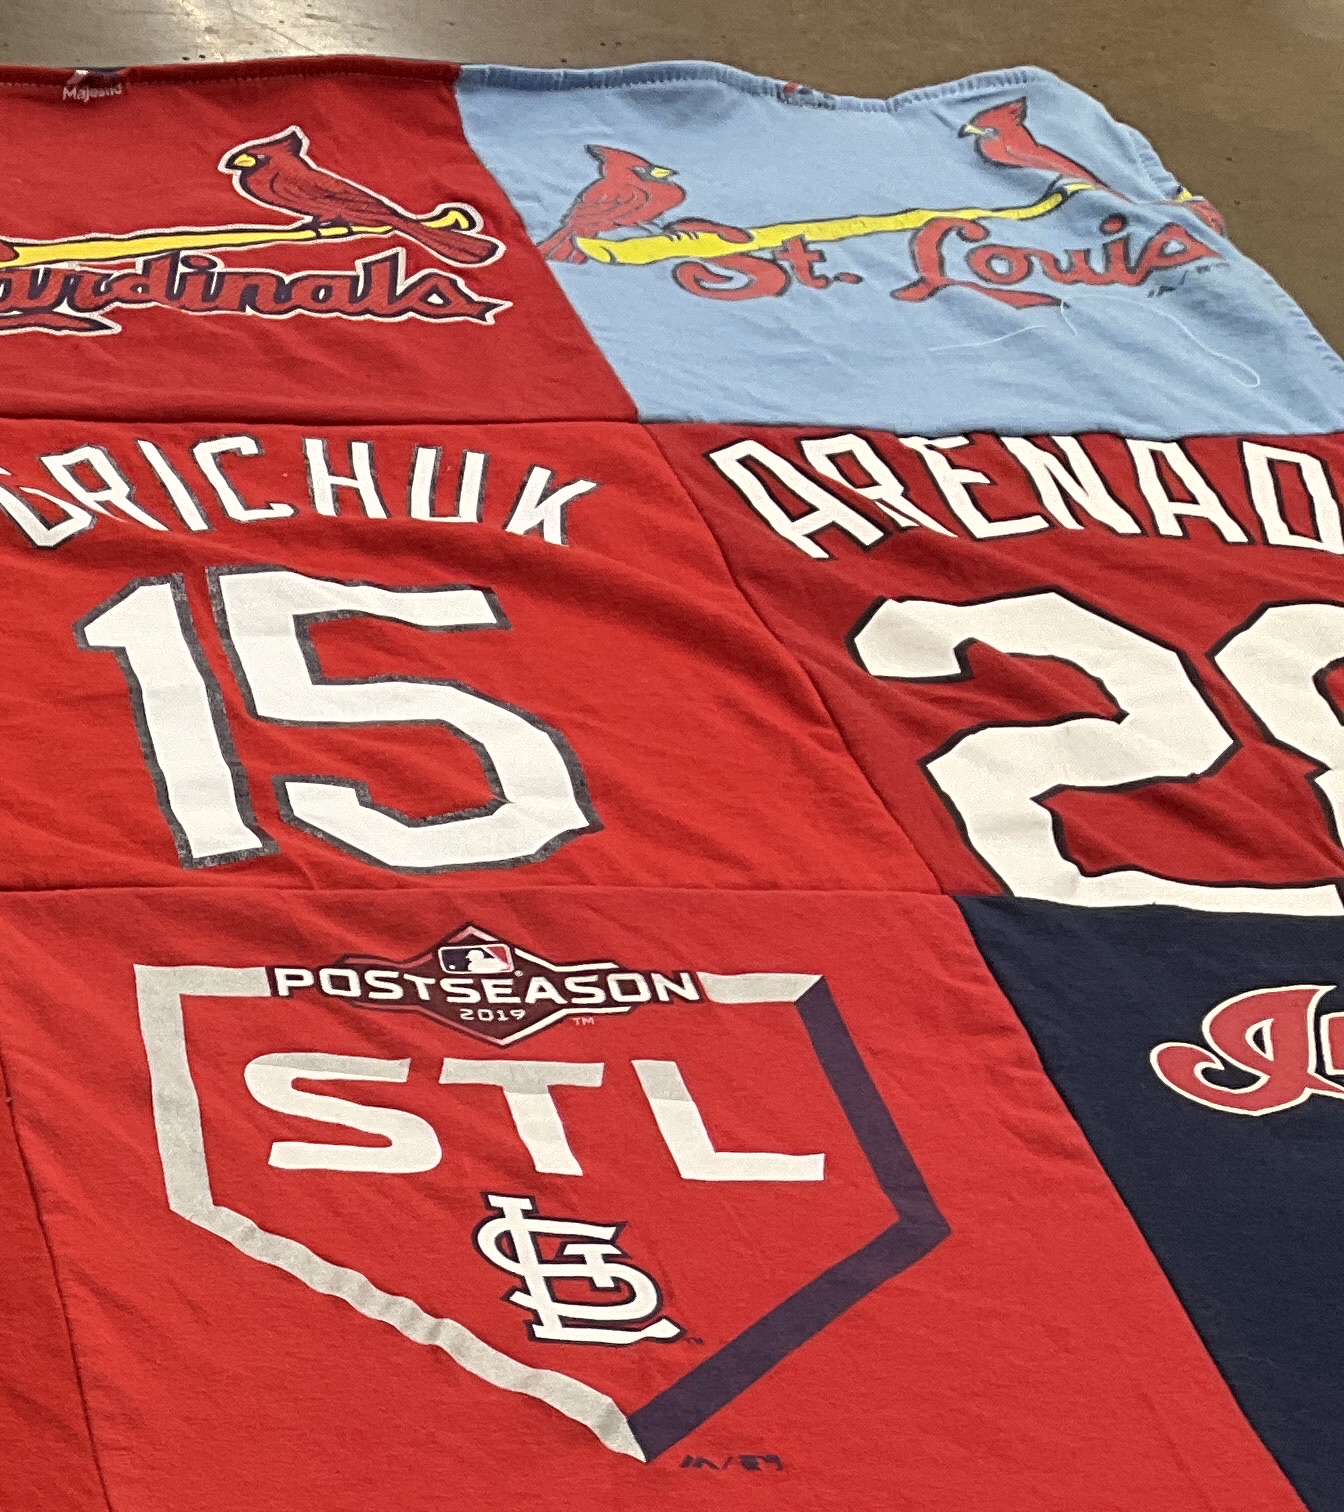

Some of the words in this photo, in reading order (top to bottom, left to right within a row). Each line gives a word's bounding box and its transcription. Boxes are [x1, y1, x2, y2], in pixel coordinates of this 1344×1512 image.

[669, 225, 865, 301] St.
[892, 214, 1225, 309] Louis
[73, 564, 605, 874] 15
[274, 963, 702, 1005] POSTSEASON
[459, 1008, 526, 1022] 2019
[243, 1051, 825, 1182] STL
